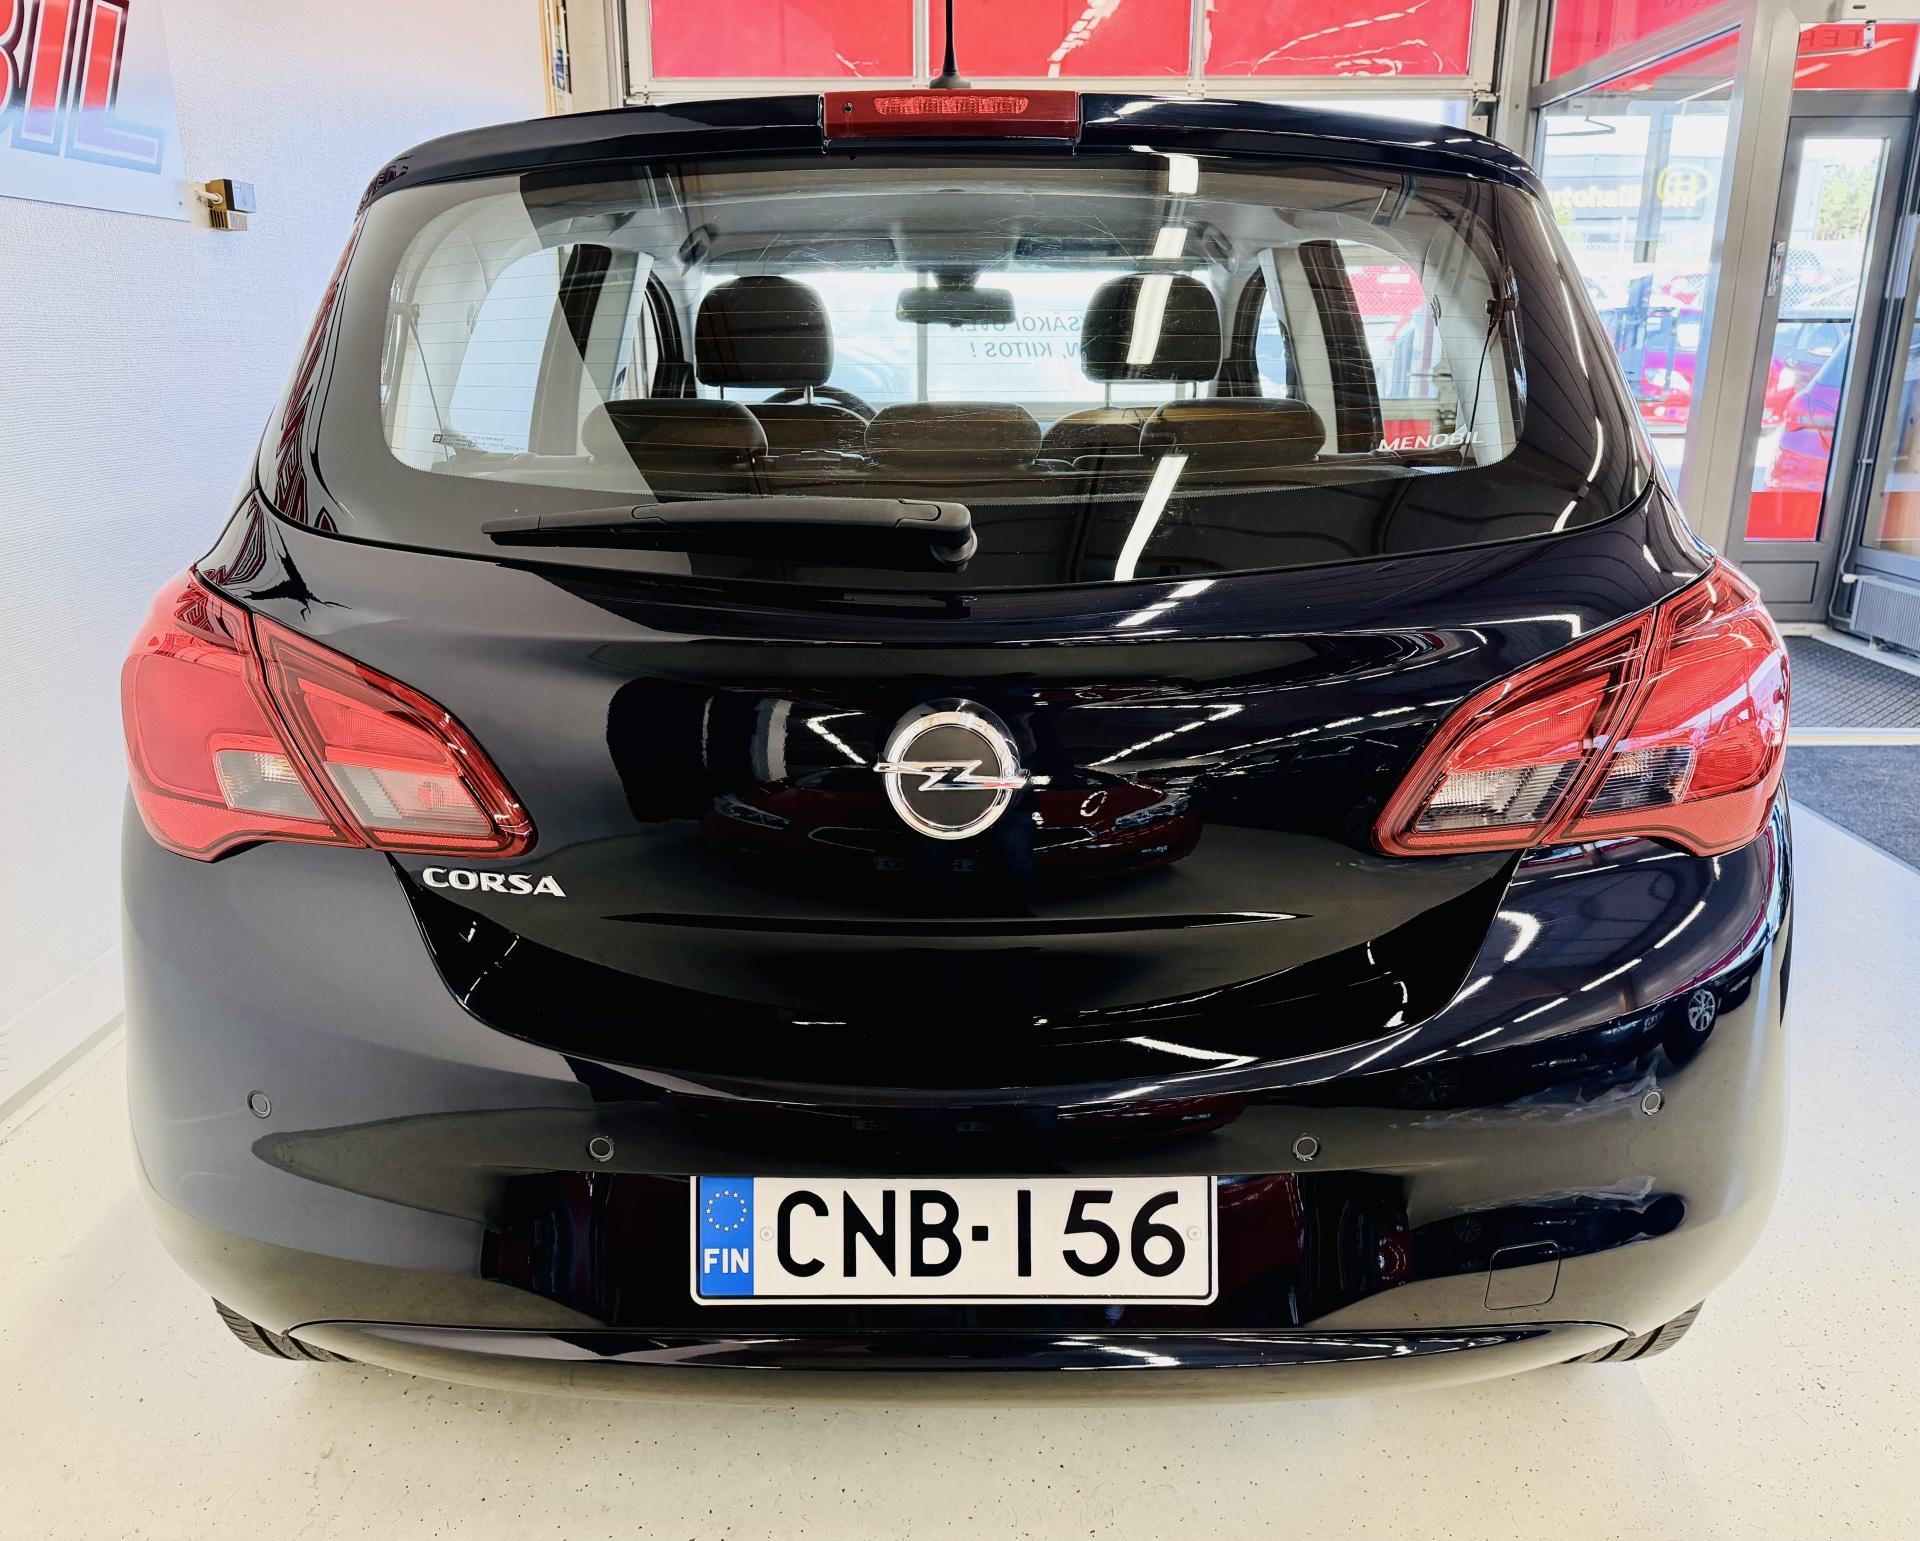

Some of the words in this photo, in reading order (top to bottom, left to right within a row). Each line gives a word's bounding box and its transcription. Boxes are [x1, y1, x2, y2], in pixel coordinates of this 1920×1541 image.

[1378, 431, 1485, 451] MENOBIL
[422, 867, 567, 898] CORSA
[776, 1189, 1186, 1278] CNB-156
[704, 1248, 750, 1275] FIN
